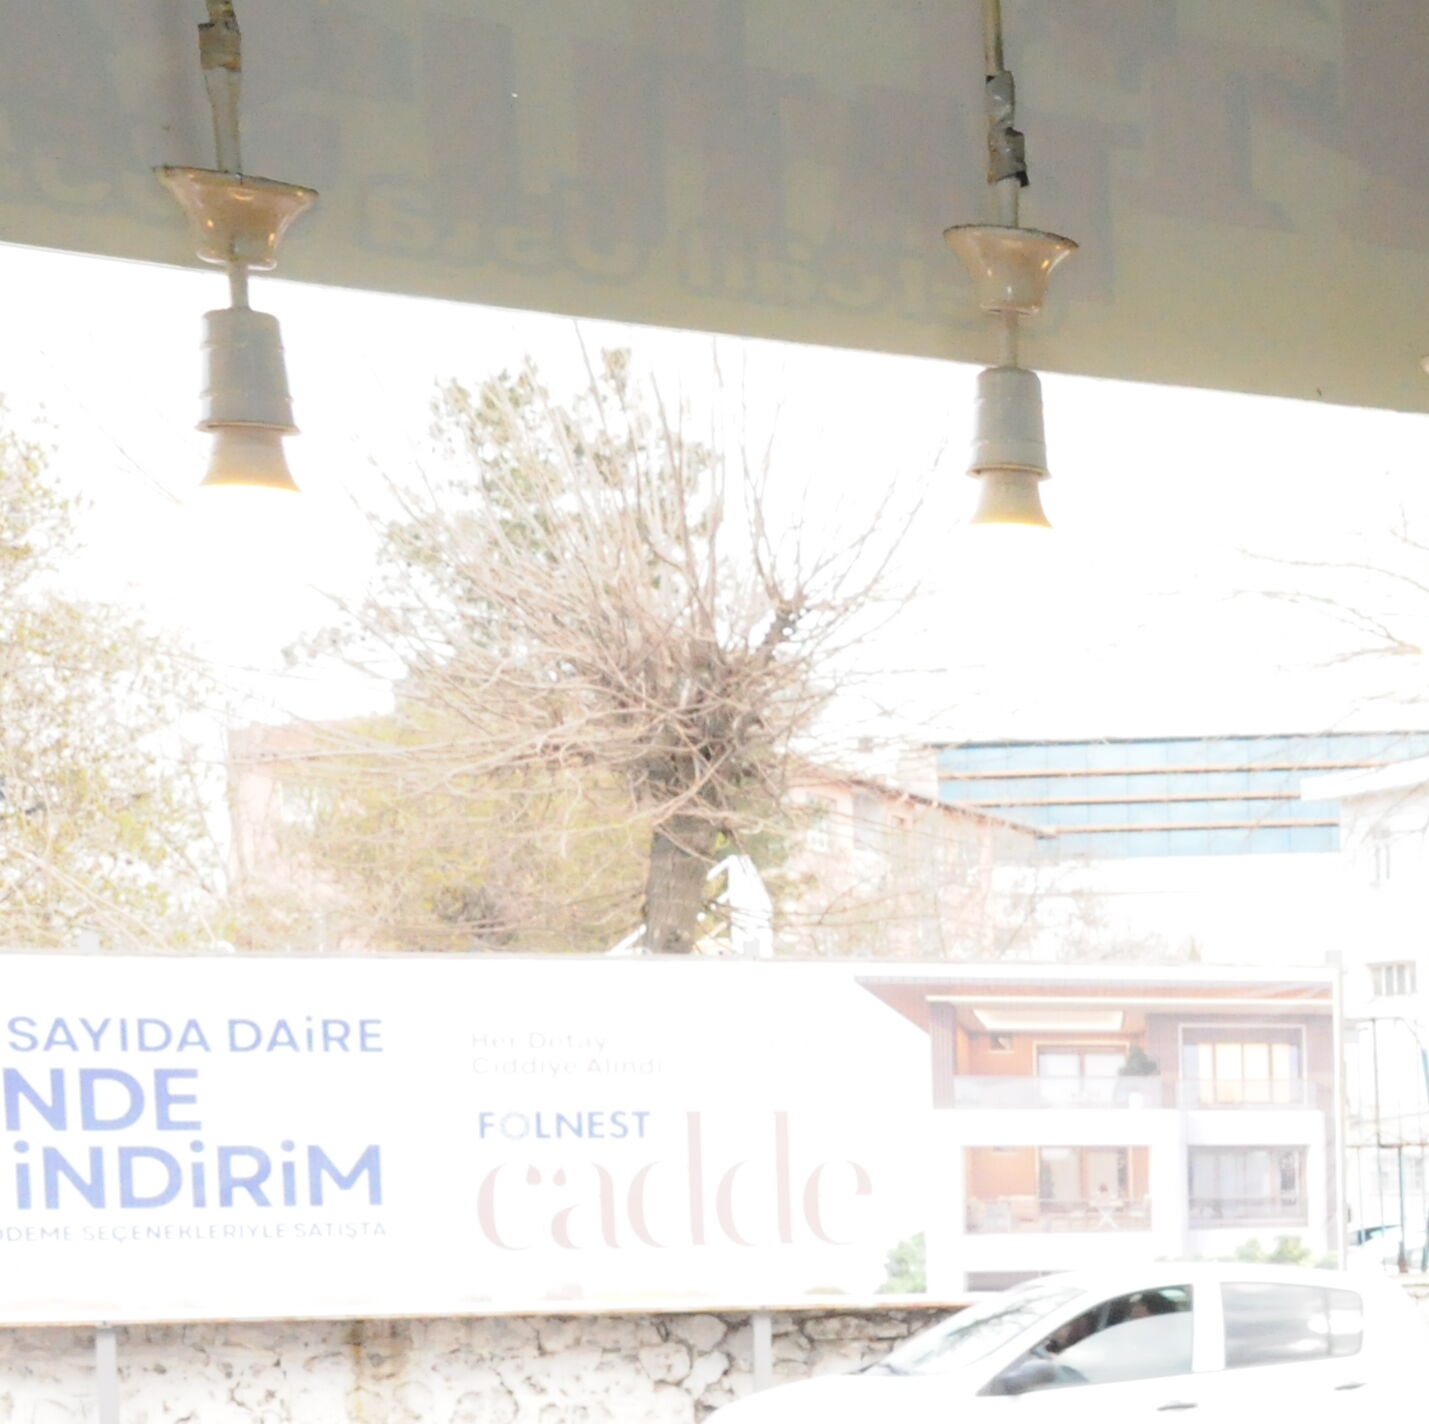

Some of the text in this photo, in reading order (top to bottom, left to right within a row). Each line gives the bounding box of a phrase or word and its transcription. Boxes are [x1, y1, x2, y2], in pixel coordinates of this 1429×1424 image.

[8, 1015, 211, 1053] SAYIDA
[2, 1067, 202, 1132] NDE
[477, 1110, 651, 1141] FOLNEST
